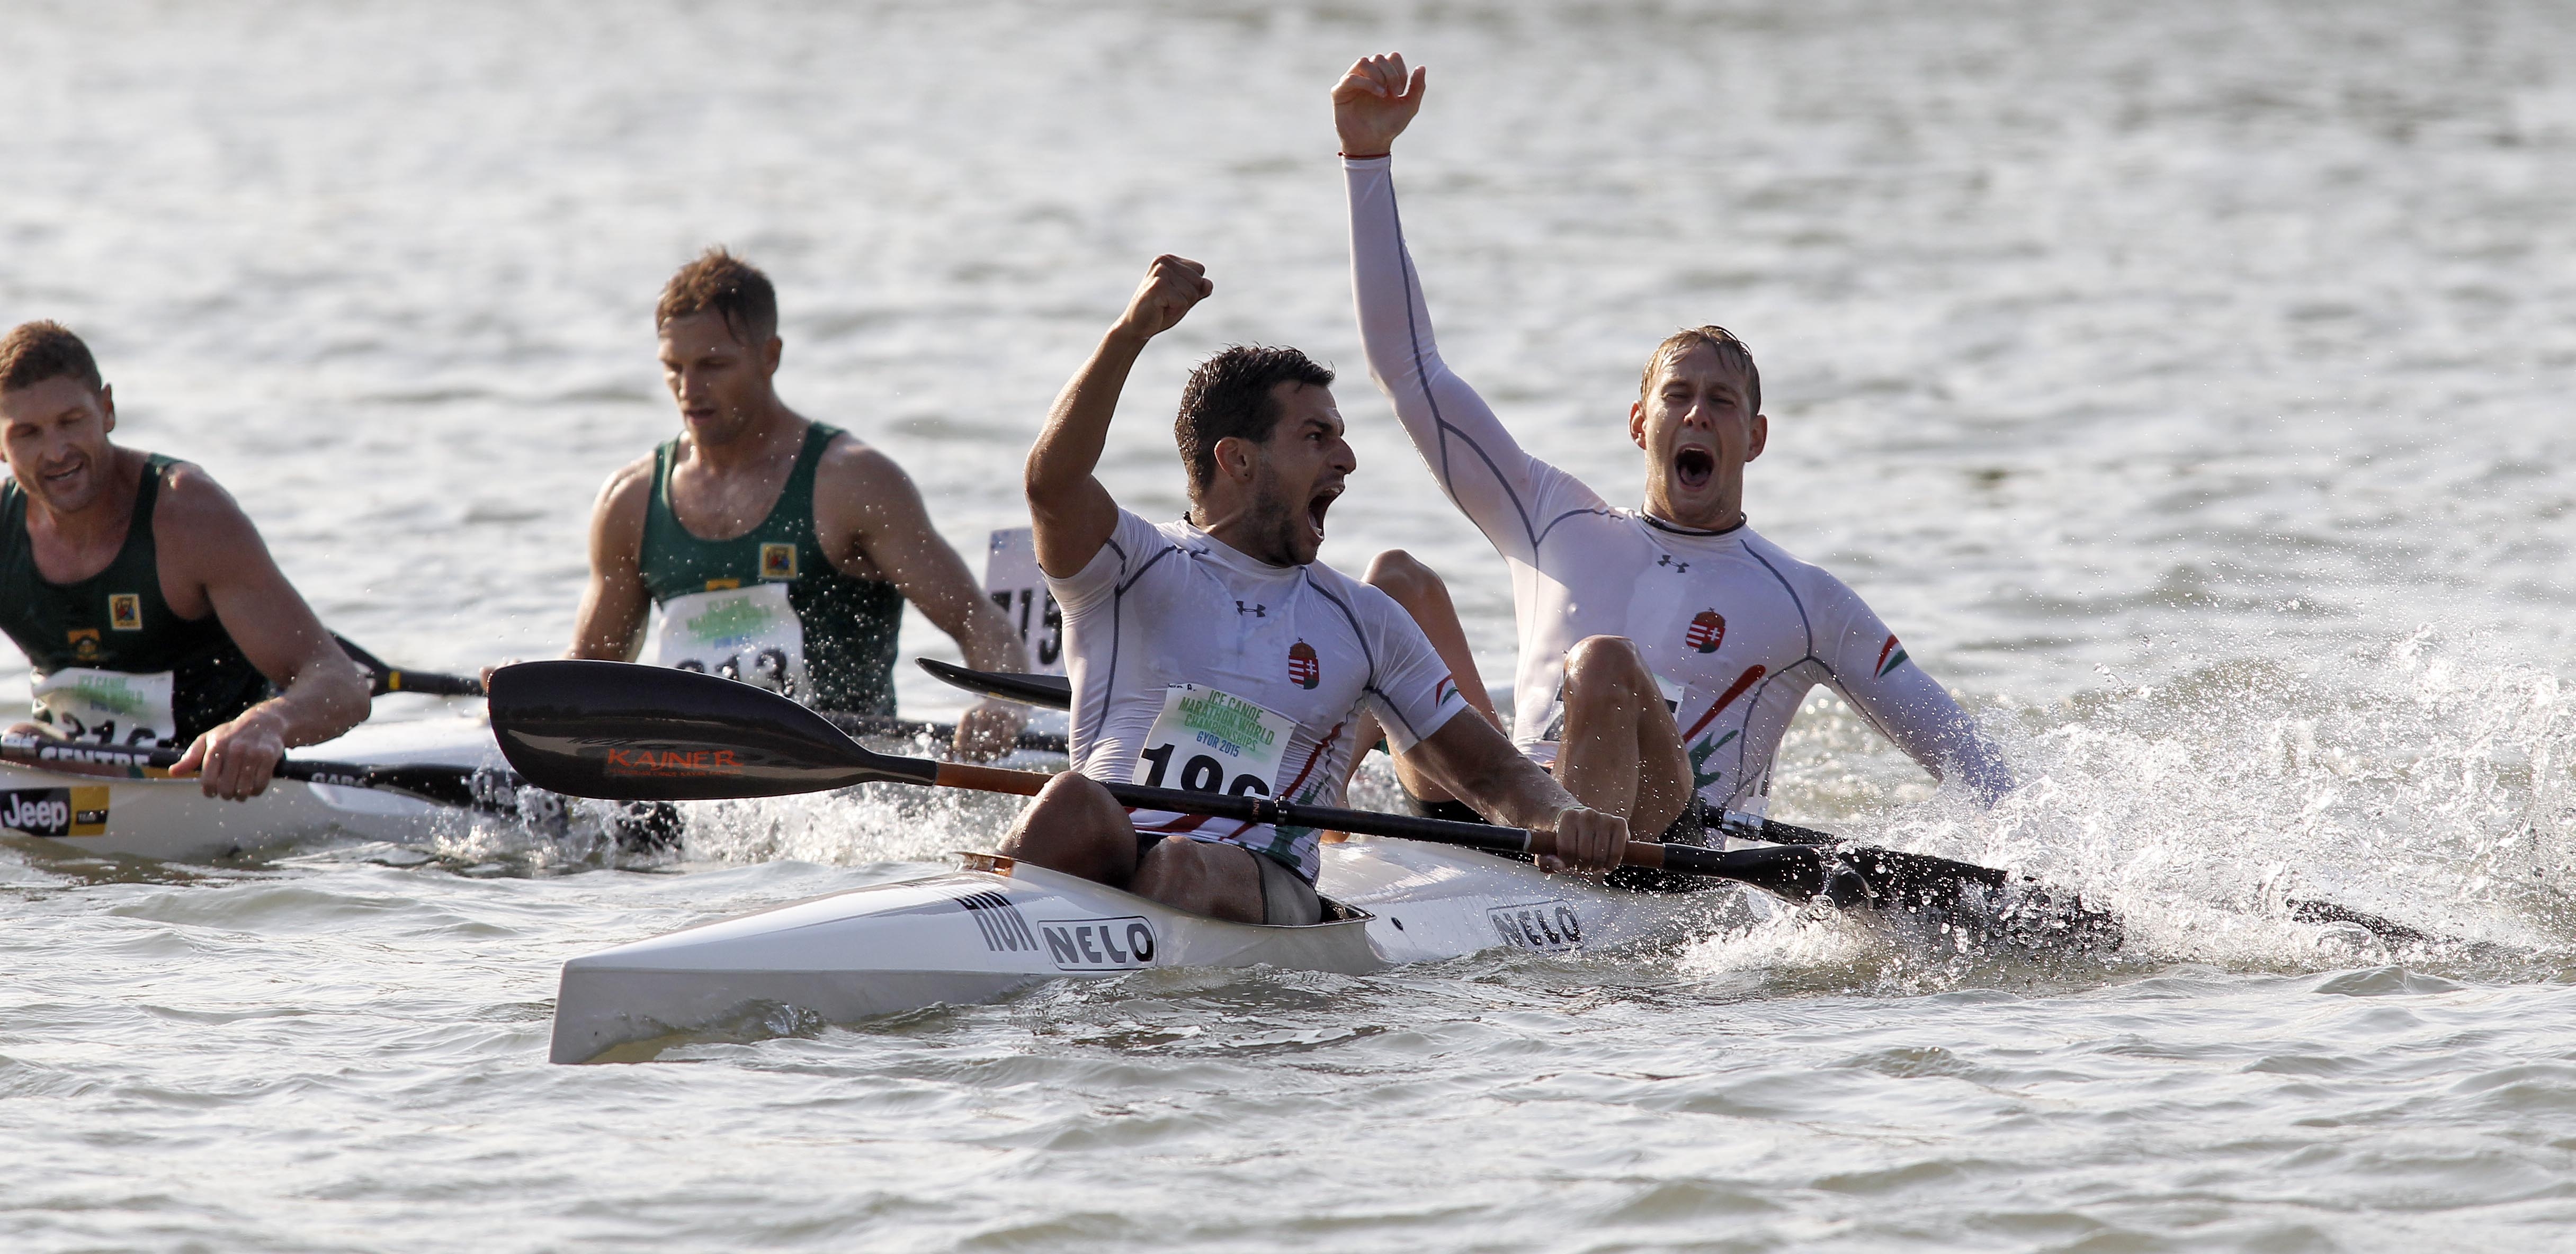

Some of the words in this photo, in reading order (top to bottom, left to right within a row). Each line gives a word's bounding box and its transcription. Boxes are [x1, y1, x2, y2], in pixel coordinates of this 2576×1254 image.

[1178, 696, 1237, 727] MARATHON
[1238, 717, 1275, 746] WORLD
[1208, 690, 1227, 705] ICF
[1227, 697, 1264, 724] CANOE
[1185, 714, 1258, 752] CHAMPIONSHIPS
[1196, 731, 1220, 749] GYOR
[1219, 740, 1240, 757] 2015
[3, 793, 67, 833] Jeep
[1043, 922, 1155, 964] NELO
[1491, 906, 1581, 948] NELO
